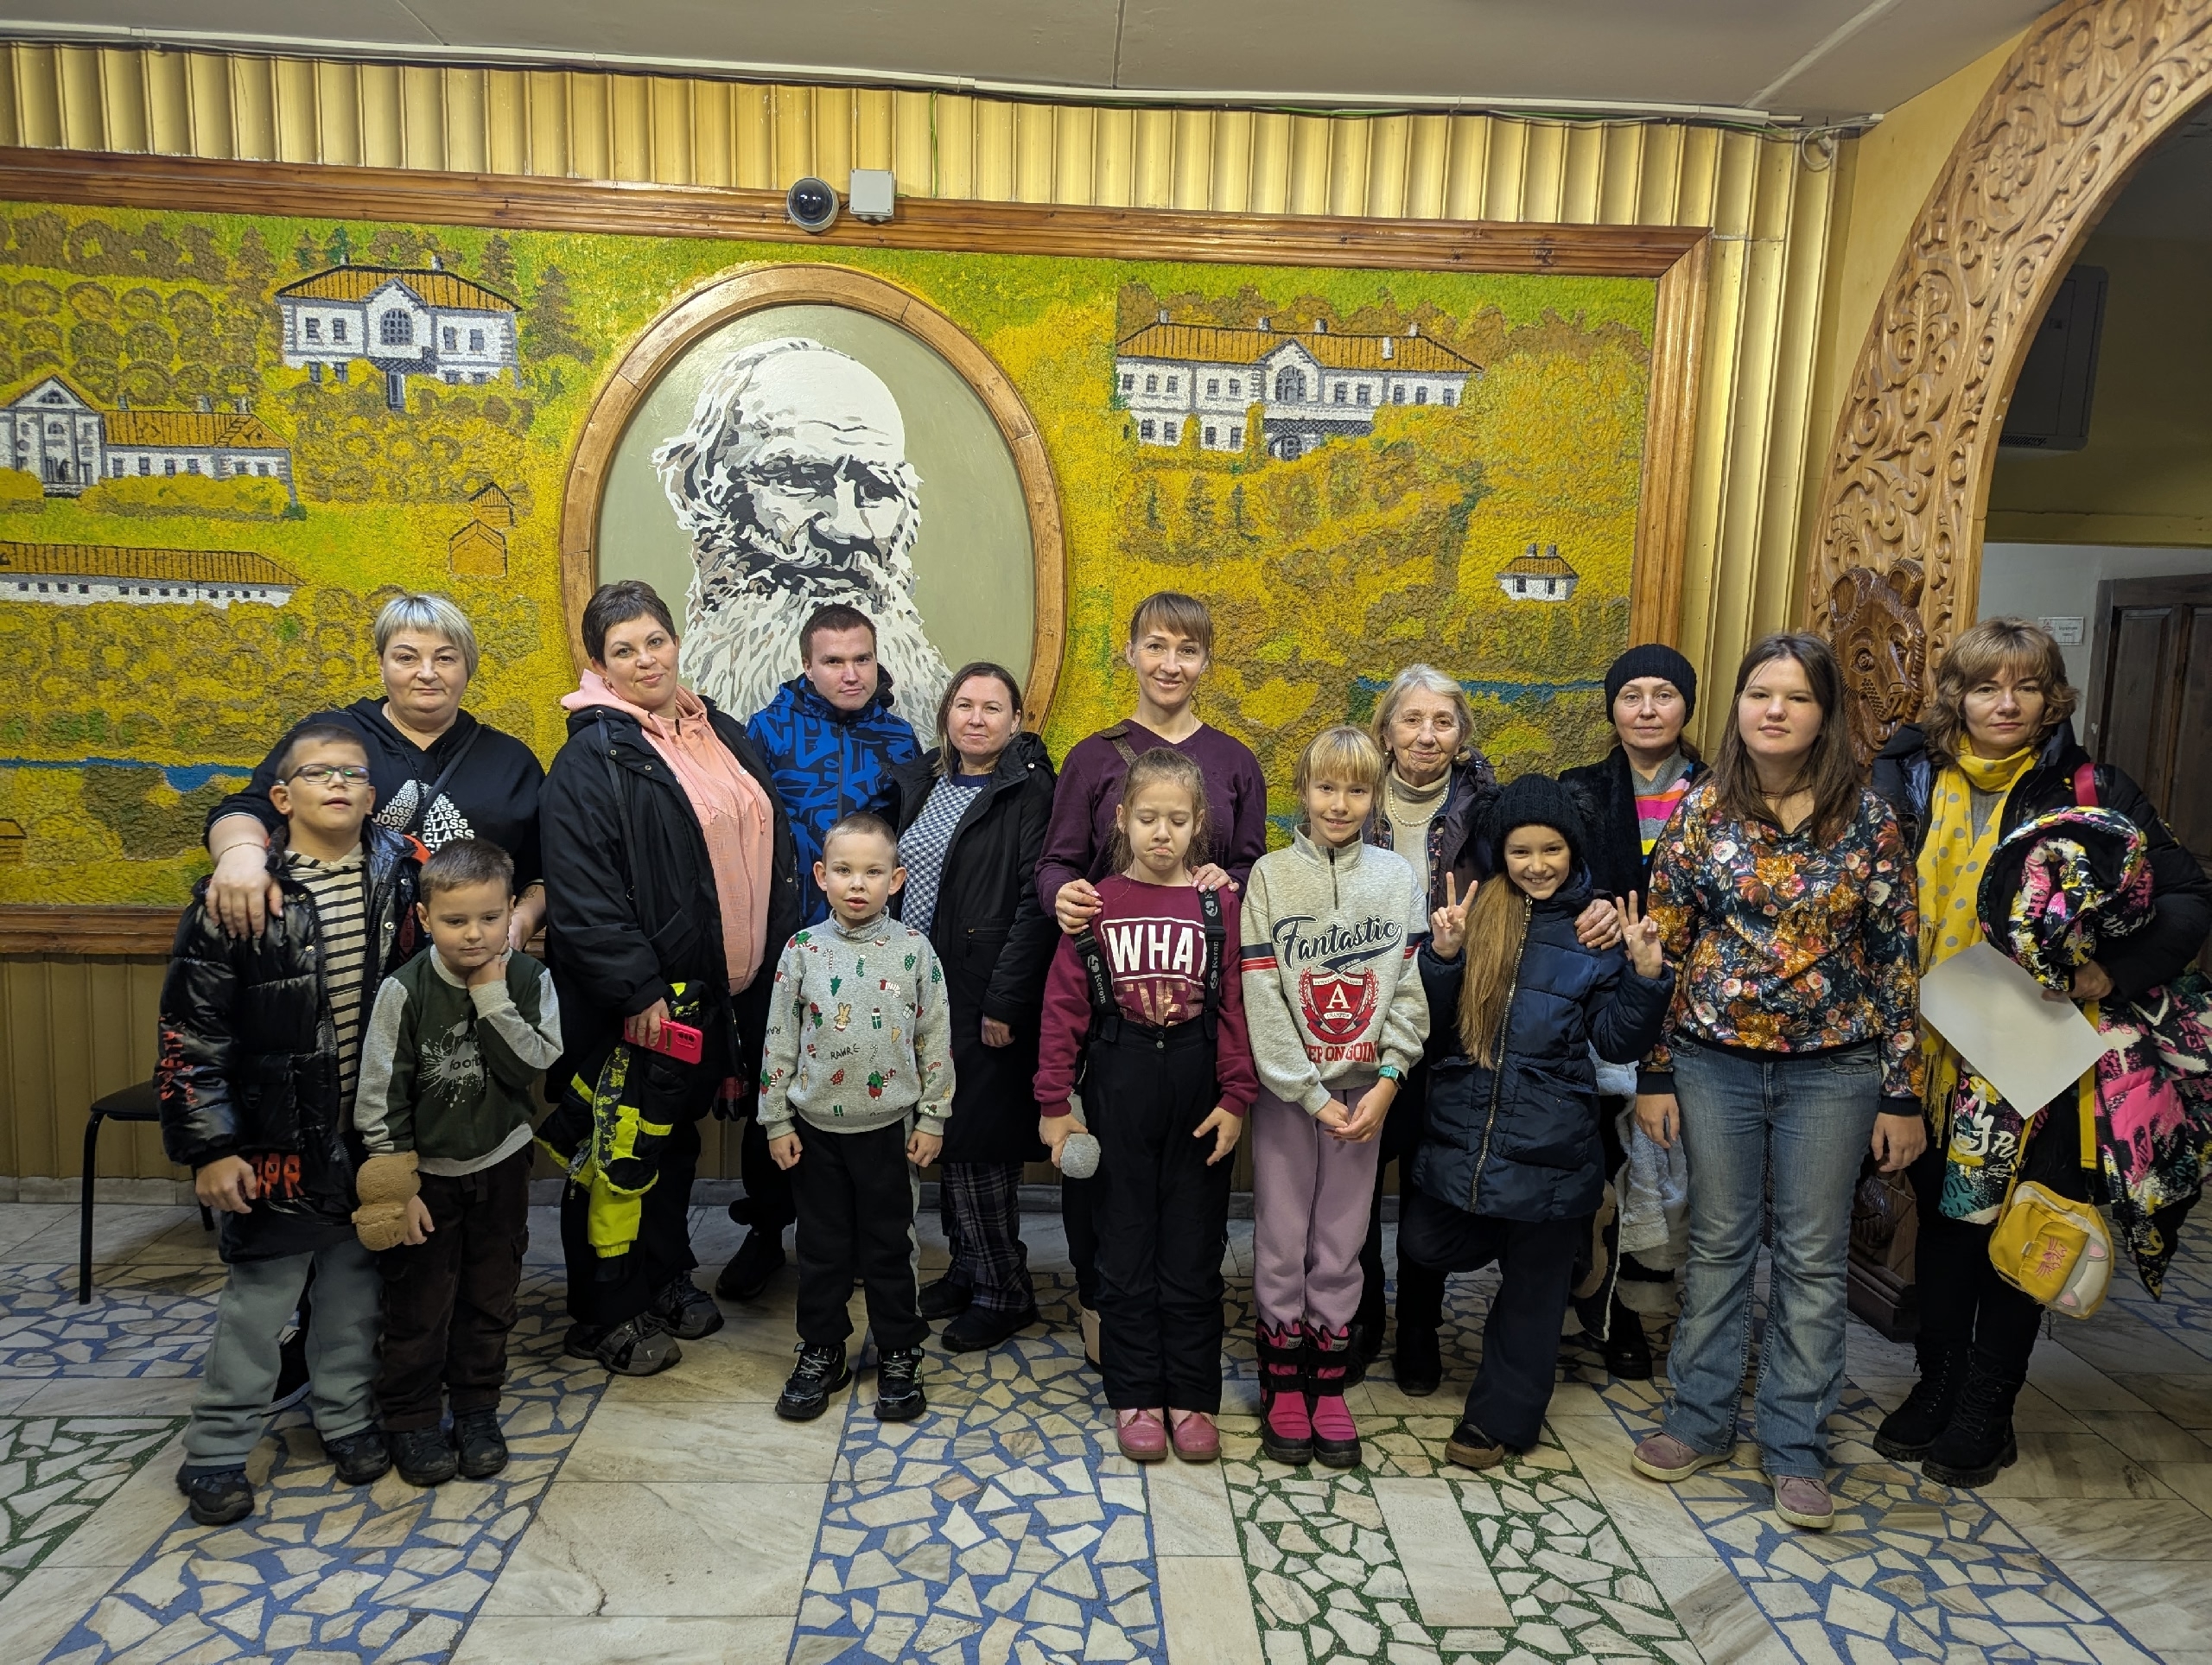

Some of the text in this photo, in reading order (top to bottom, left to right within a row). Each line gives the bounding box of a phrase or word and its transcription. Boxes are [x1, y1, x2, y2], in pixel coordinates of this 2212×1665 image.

[422, 829, 475, 843] CLASS
[423, 819, 468, 832] CLASS
[1272, 915, 1402, 970] Fantastic
[1326, 983, 1351, 1009] A
[1325, 1045, 1346, 1062] ON
[1345, 1040, 1379, 1063] GOIN
